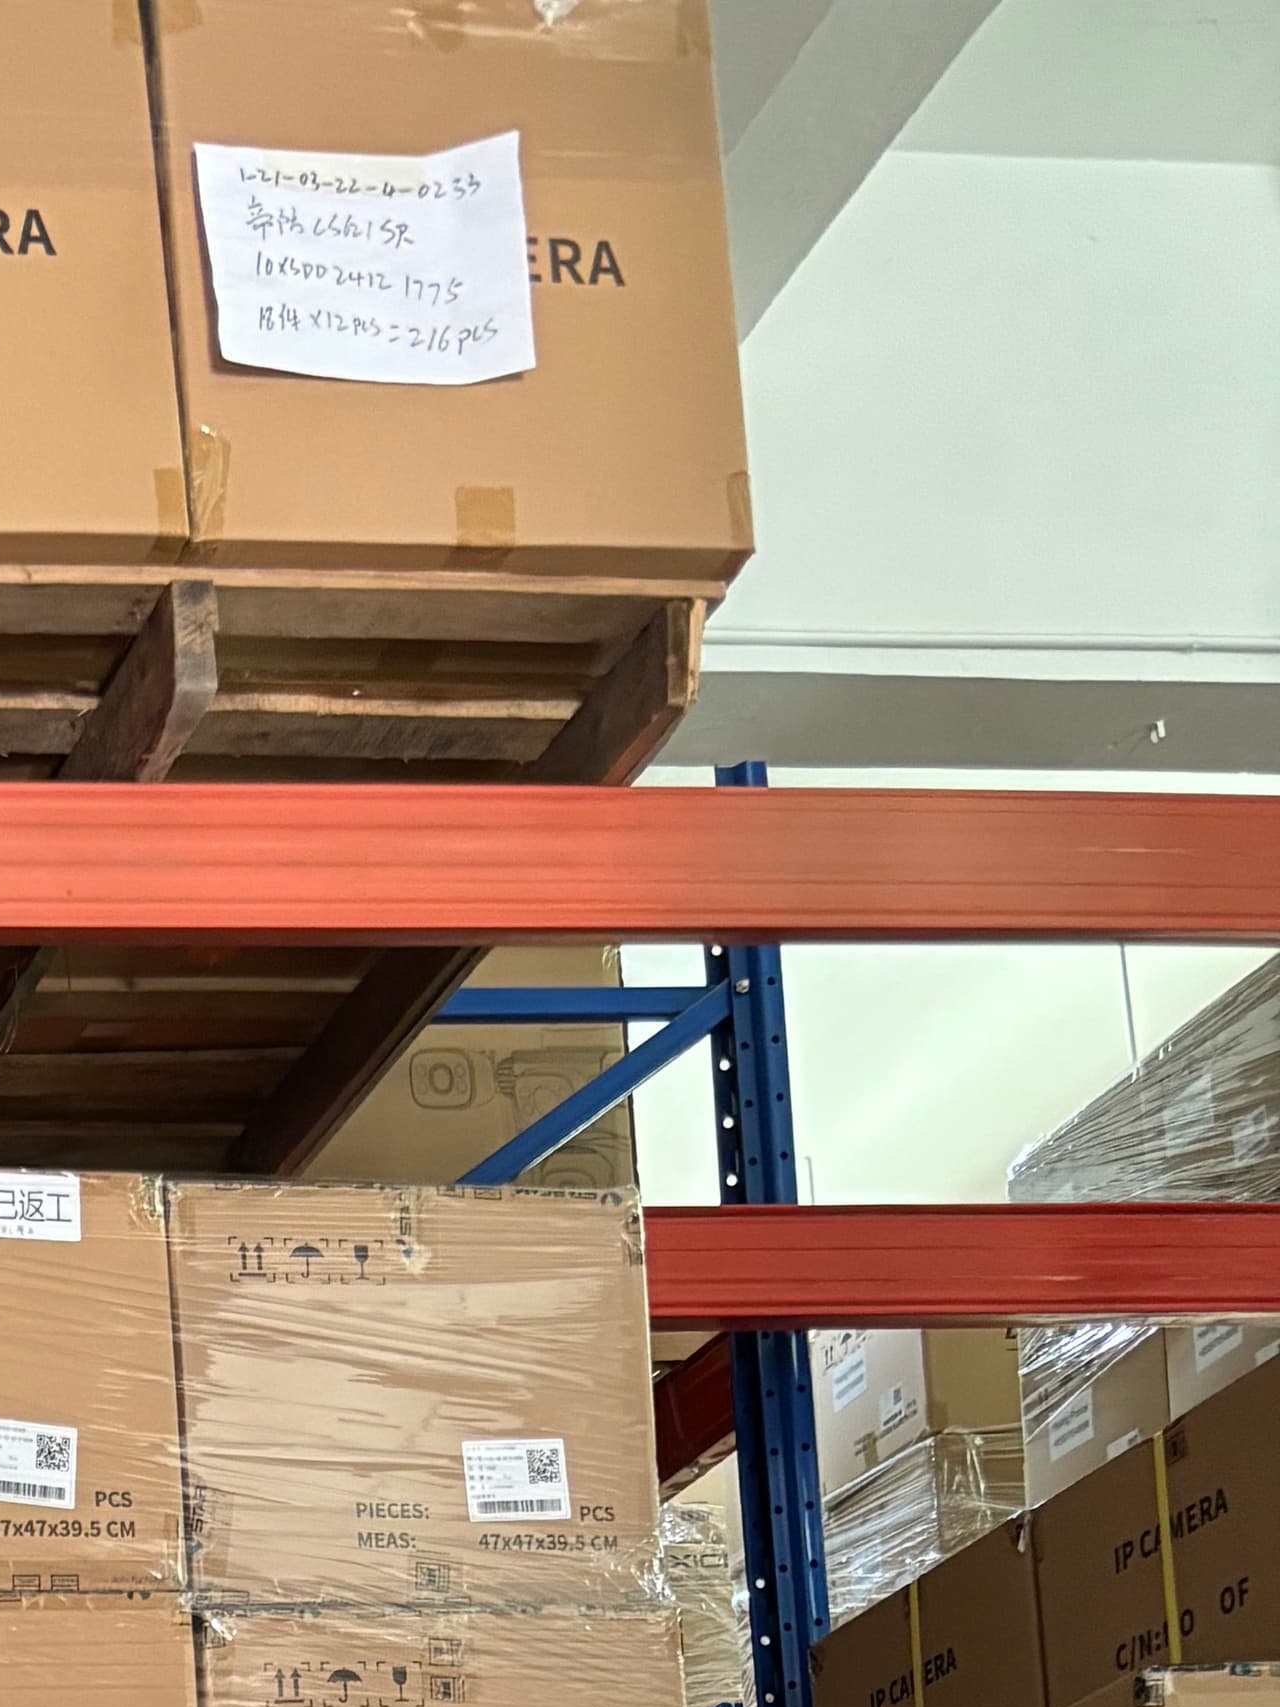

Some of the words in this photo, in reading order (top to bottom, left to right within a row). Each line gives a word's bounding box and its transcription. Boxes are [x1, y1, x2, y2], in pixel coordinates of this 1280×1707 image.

[528, 238, 626, 287] ERA
[95, 1491, 133, 1508] PCS
[356, 1503, 430, 1519] PIECES:
[580, 1506, 615, 1522] PCS
[106, 1521, 136, 1538] CM
[358, 1532, 416, 1549] MEAS:
[479, 1534, 585, 1551] 47x47x39.5
[590, 1535, 618, 1551] CM
[1114, 1543, 1134, 1574] IP
[1116, 1609, 1195, 1672] C/N:O
[1219, 1577, 1250, 1616] OF
[889, 1648, 957, 1705] CAERA
